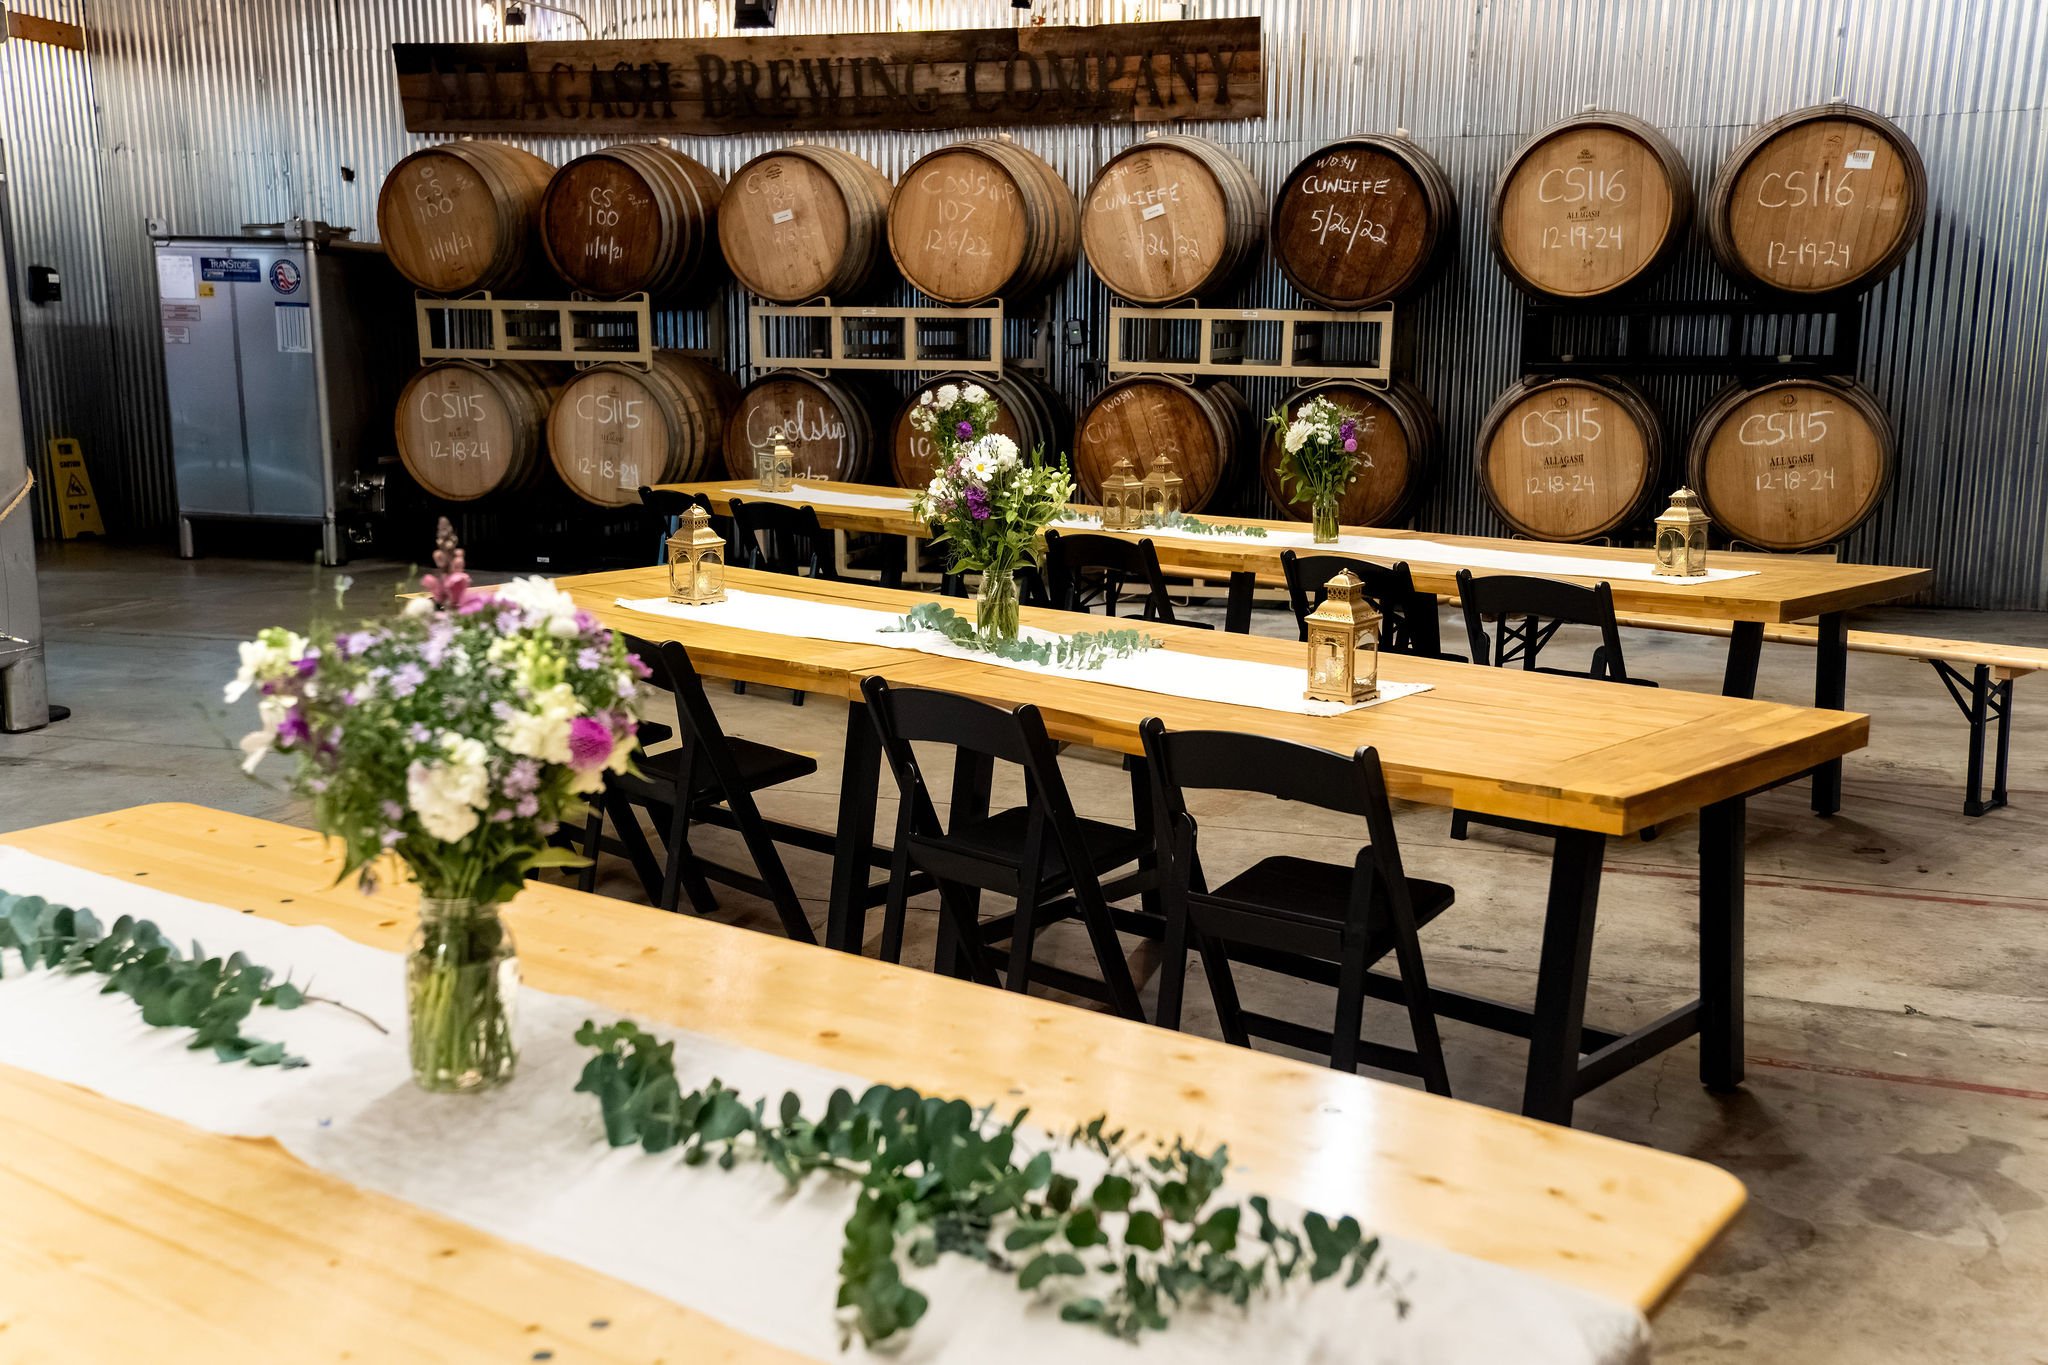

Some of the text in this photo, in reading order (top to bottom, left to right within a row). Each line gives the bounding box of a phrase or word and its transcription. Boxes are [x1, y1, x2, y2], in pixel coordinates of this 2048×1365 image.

[424, 44, 1239, 119] ALLAGASH BREWING COMPANY
[590, 186, 615, 208] CS
[1093, 182, 1181, 212] CUNLIFFE
[1302, 175, 1391, 194] CUNLIFFE
[1539, 167, 1626, 203] CS116
[1758, 171, 1854, 207] CS116
[589, 206, 619, 227] 100
[938, 200, 976, 224] 107
[1311, 204, 1388, 253] 5/26/22
[1542, 225, 1622, 250] 12-19-24
[585, 235, 623, 264] 11/11/21
[1767, 240, 1850, 269] 12-19-24
[420, 391, 486, 423] CS115
[576, 394, 643, 428] CS115
[1522, 407, 1601, 446] CS115
[1739, 410, 1835, 445] CS115
[430, 441, 490, 461] 12-18-24
[1543, 453, 1585, 466] ALLAGASH
[1769, 453, 1815, 467] ALLAGASH
[1756, 467, 1834, 491] 12-18-24
